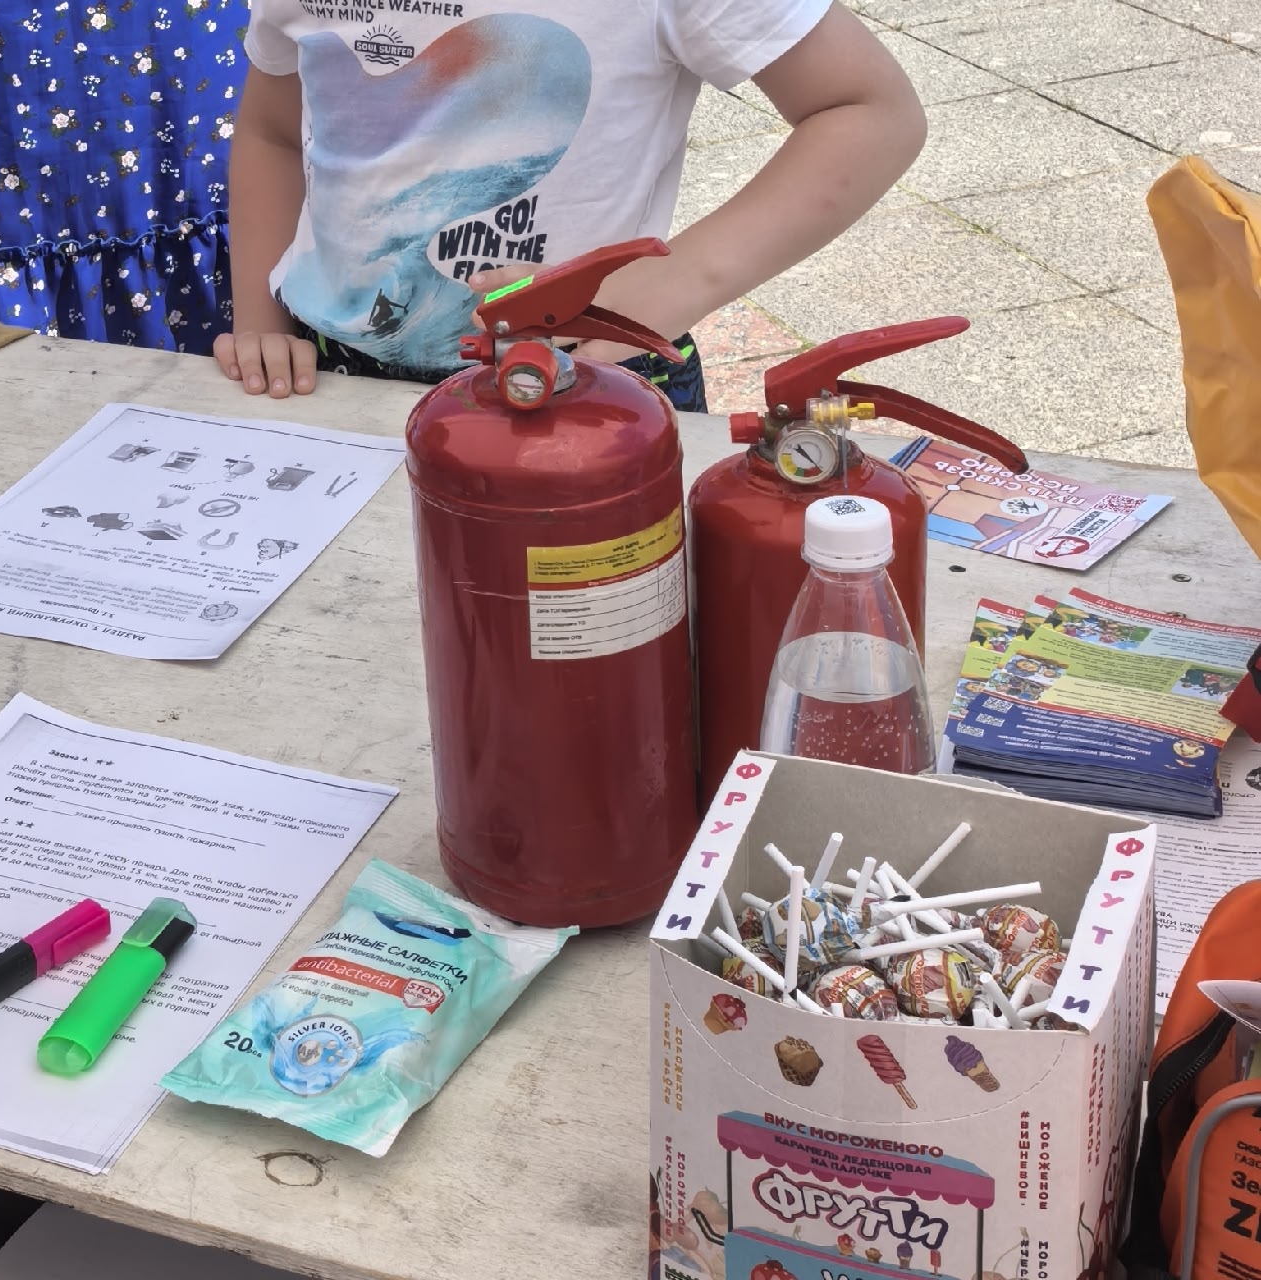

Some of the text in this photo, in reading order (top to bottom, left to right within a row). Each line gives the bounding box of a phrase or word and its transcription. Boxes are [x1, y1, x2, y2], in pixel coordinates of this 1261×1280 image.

[316, 6, 334, 20] MY
[338, 8, 375, 23] MIND
[356, 42, 414, 57] SOUL SURFER
[494, 195, 539, 235] GO!
[438, 221, 548, 264] WITH THE
[934, 458, 1086, 508] ПУТЬ СКВОЗЬ
[48, 749, 79, 761] Задача
[37, 778, 80, 792] пришлось
[114, 795, 166, 809] пожарным?
[50, 773, 75, 783] огонь
[78, 779, 134, 794] перекинулся
[190, 803, 218, 813] пятый
[233, 812, 267, 824] шестой
[124, 781, 169, 794] загорелся
[298, 819, 350, 832] пожарного
[186, 836, 235, 851] пожарным.
[666, 762, 762, 931] ФРУТТИ
[15, 833, 51, 845] машина
[53, 842, 92, 854] выехала
[103, 853, 129, 863] месту
[168, 868, 189, 877] Для
[217, 879, 246, 889] чтобы
[247, 886, 298, 899] добраться
[22, 861, 50, 871] места
[50, 867, 93, 879] пожара?
[96, 860, 126, 871] прямо
[162, 875, 190, 886] после
[192, 883, 244, 898] повернула
[37, 854, 75, 867] Сколько
[76, 865, 132, 881] километров
[183, 889, 230, 904] пожарная
[233, 901, 272, 912] машина
[9, 886, 64, 903] километров
[211, 933, 262, 947] пожарной
[1062, 837, 1144, 1014] ФРУТТИ
[297, 957, 399, 991] antibacterial
[319, 930, 469, 986] ЛАЖНЫЕ САЛФЕТКИ
[170, 984, 223, 999] потратили
[178, 976, 229, 990] потратила
[288, 984, 320, 999] ионами
[320, 993, 354, 1007] серебра
[407, 982, 440, 1001] STOP
[164, 1002, 210, 1016] горящем
[187, 997, 217, 1009] месту
[223, 1031, 253, 1054] 20
[287, 1020, 352, 1044] SILVER IONS
[764, 1112, 944, 1158] ВКУС МОРОЖЕНОГО
[774, 1135, 932, 1175] КАРАМЕЛЬ ЛЕДЕНЦОВАЯ
[811, 1157, 893, 1181] НА ПАЛОЧКЕ
[1038, 1121, 1051, 1210] МОРОЖЕНОЕ
[1231, 1170, 1261, 1195] Зе
